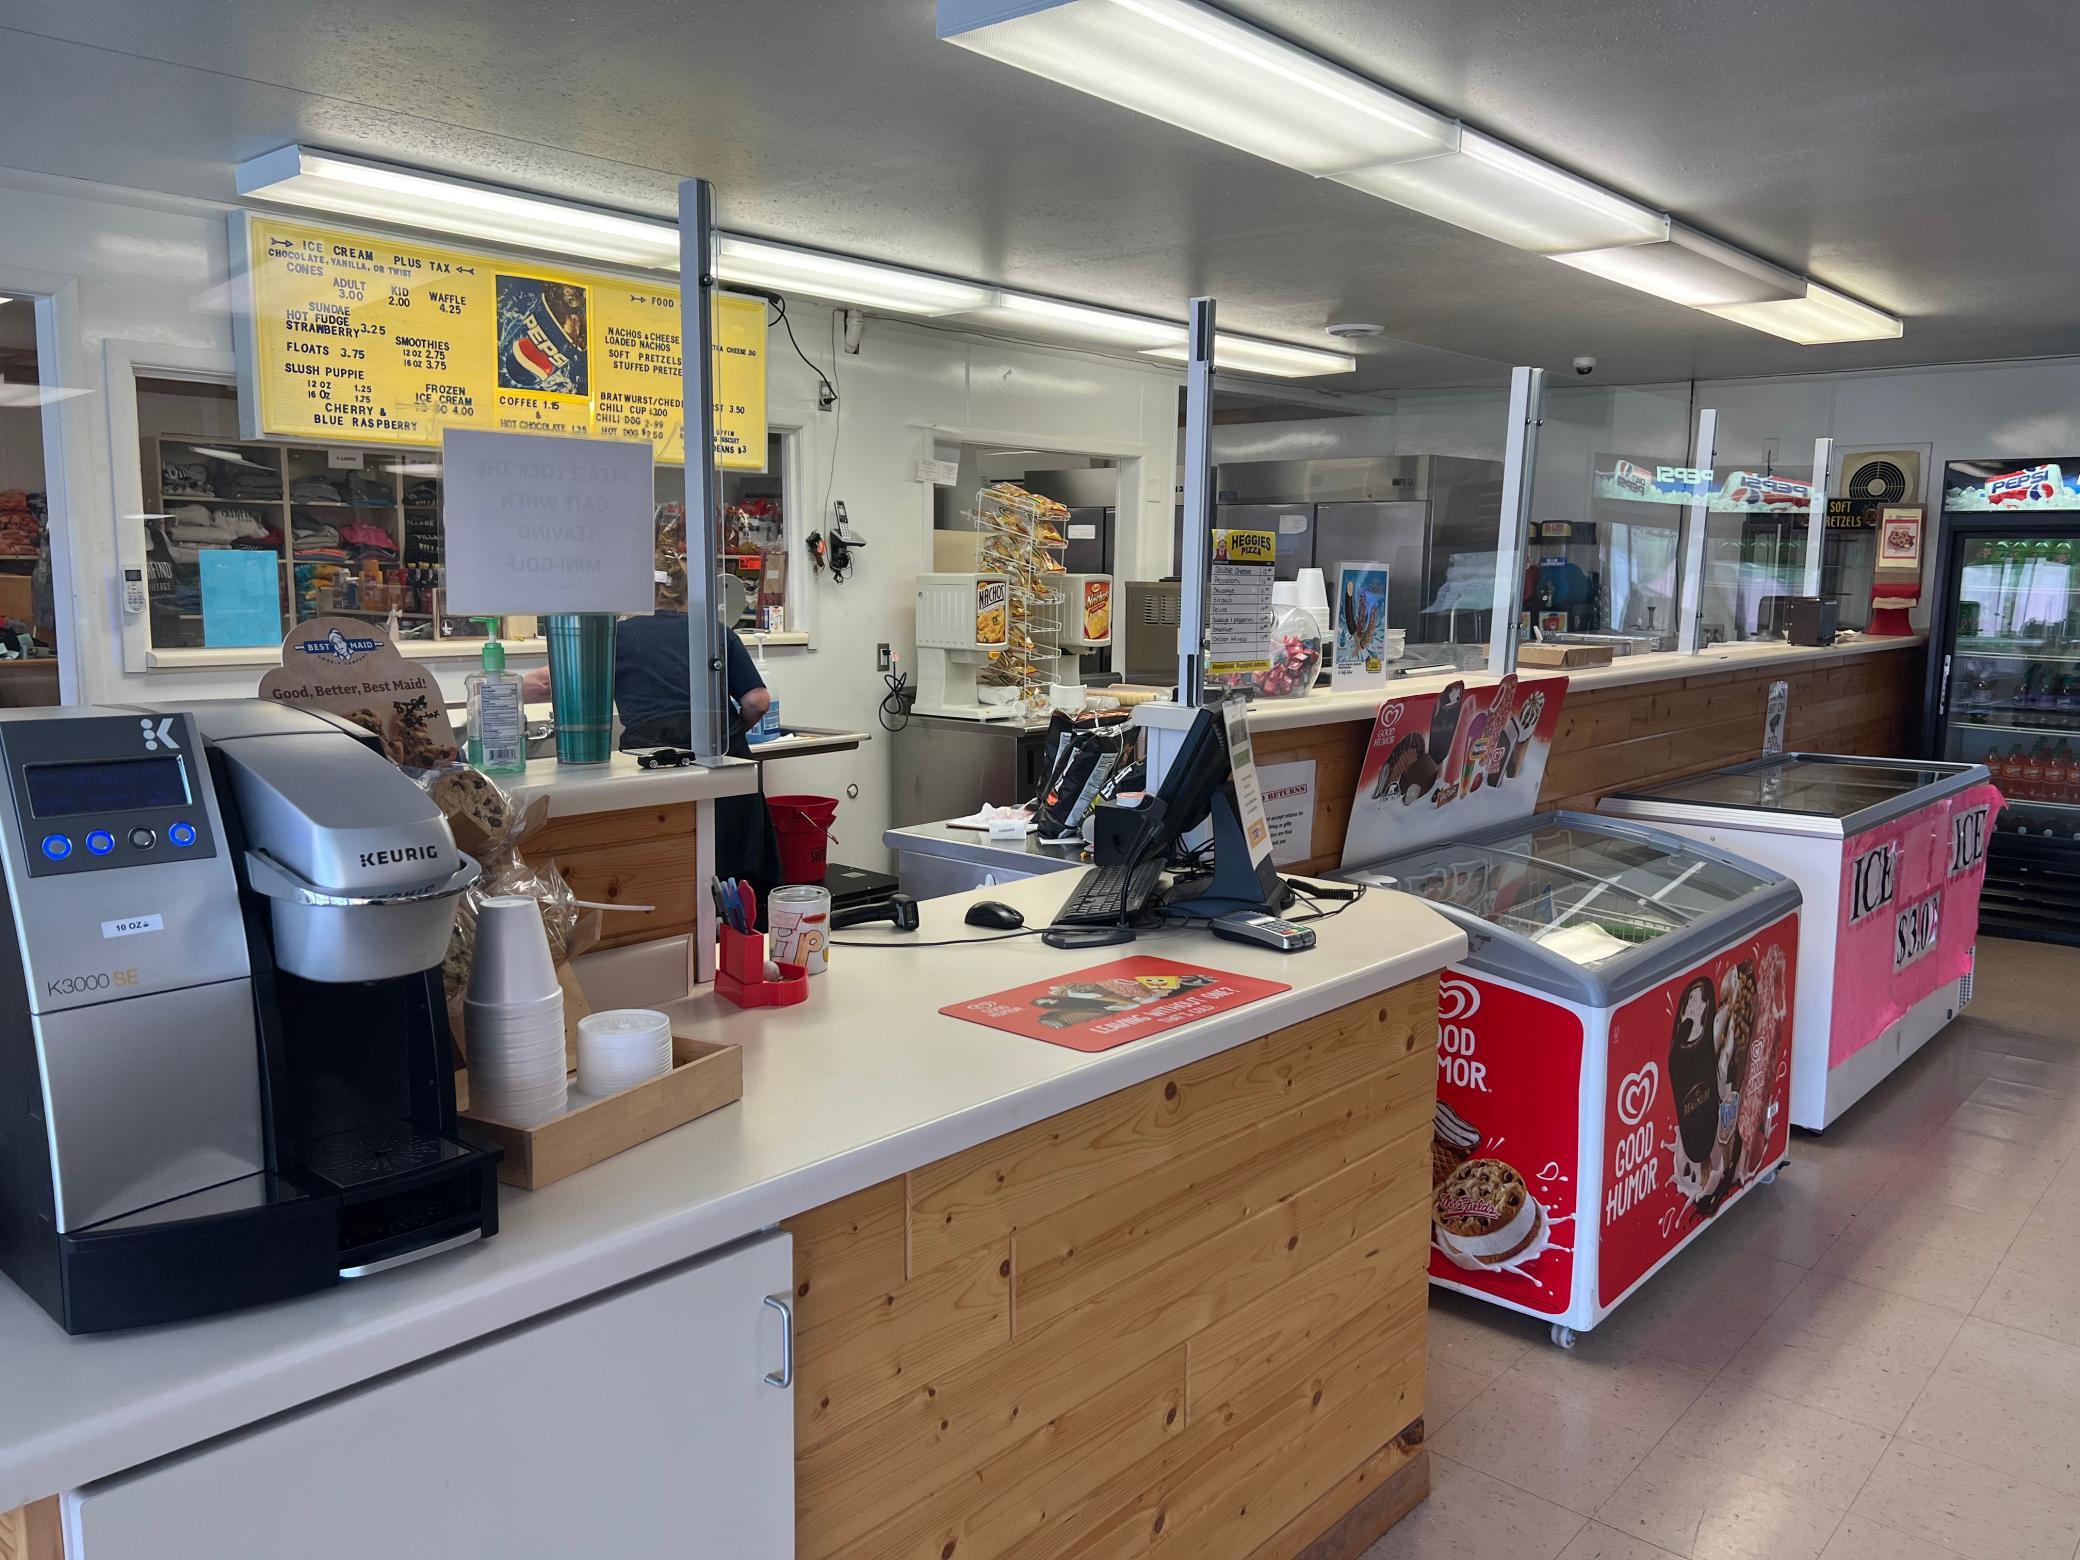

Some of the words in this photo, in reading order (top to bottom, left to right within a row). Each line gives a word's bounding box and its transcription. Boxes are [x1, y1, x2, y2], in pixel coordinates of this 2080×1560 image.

[303, 240, 323, 252] ICE
[333, 246, 374, 261] CREAM
[394, 256, 422, 269] PLUS
[429, 261, 451, 273] TAX
[287, 262, 324, 277] CONES
[373, 264, 385, 273] OR
[388, 267, 412, 278] TWIST
[333, 278, 366, 292] ADULT
[391, 286, 409, 297] KID
[429, 292, 466, 306] WAFFLE
[308, 302, 351, 316] SUNDAE
[339, 289, 364, 301] 3.00
[388, 297, 410, 308] 2.00
[439, 303, 462, 315] 4.25
[651, 297, 674, 308] FOOD
[286, 309, 308, 322] HOT
[315, 313, 350, 327] FUDGE
[286, 320, 360, 338] STRAWBERRY
[360, 323, 386, 336] 3.25
[608, 327, 642, 339] NACHOS
[650, 333, 680, 345] CHEESE
[287, 342, 330, 356] FLOATS
[340, 348, 365, 360] 3.75
[395, 336, 450, 351] SMOOTHIES
[604, 336, 636, 348] LOADED
[639, 340, 671, 352] NACHOS
[403, 349, 410, 357] 12
[412, 350, 422, 358] OZ
[425, 349, 446, 361] 2.75
[609, 349, 630, 360] SOFT
[639, 352, 682, 365] PRETZELS
[285, 363, 320, 376] SLUSH
[325, 366, 364, 380] PUPPIE
[404, 359, 411, 368] 16
[412, 360, 422, 368] OZ
[426, 359, 447, 370] 3.75
[613, 360, 650, 373] STUFFED
[653, 364, 683, 376] PRETZE
[307, 379, 317, 388] 12
[320, 380, 331, 390] OZ
[354, 384, 372, 394] 1.25
[308, 390, 317, 399] 16
[425, 384, 466, 396] FROZEN
[416, 393, 432, 403] ICE
[439, 395, 472, 406] CREAM
[500, 396, 538, 408] COFFEE
[325, 403, 374, 416] CHERRY
[379, 408, 387, 416] &
[453, 406, 474, 416] 4.00
[600, 402, 623, 412] CHILI
[630, 405, 647, 415] CUP
[729, 406, 745, 414] 3.50
[314, 414, 344, 427] BLUE
[353, 417, 418, 431] RASPBERRY
[500, 419, 517, 428] HOT
[519, 421, 566, 432] CHOCOLATE
[596, 413, 620, 423] CHILI
[625, 416, 641, 425] DOG
[623, 429, 639, 437] DOG
[1992, 470, 2049, 493] PEPSI
[1830, 501, 1852, 513] SOFT
[1825, 516, 1861, 528] RETZELS
[1231, 535, 1271, 551] HEGGIES
[1241, 547, 1261, 556] PIZZA
[979, 584, 1004, 609] NACHOS
[307, 643, 330, 651] BEST
[272, 685, 314, 700] Good,
[314, 685, 361, 697] Better,
[362, 680, 391, 694] Best
[392, 677, 427, 691] Maid!
[1952, 809, 1988, 872] ICE
[360, 846, 438, 867] KEURIG
[1851, 845, 1895, 922] ICE
[113, 968, 140, 986] SE
[1437, 1024, 1475, 1056] OD
[1437, 1055, 1488, 1092] MOR
[1614, 1121, 1655, 1179] GOOD
[1606, 1158, 1659, 1226] HUMOR
